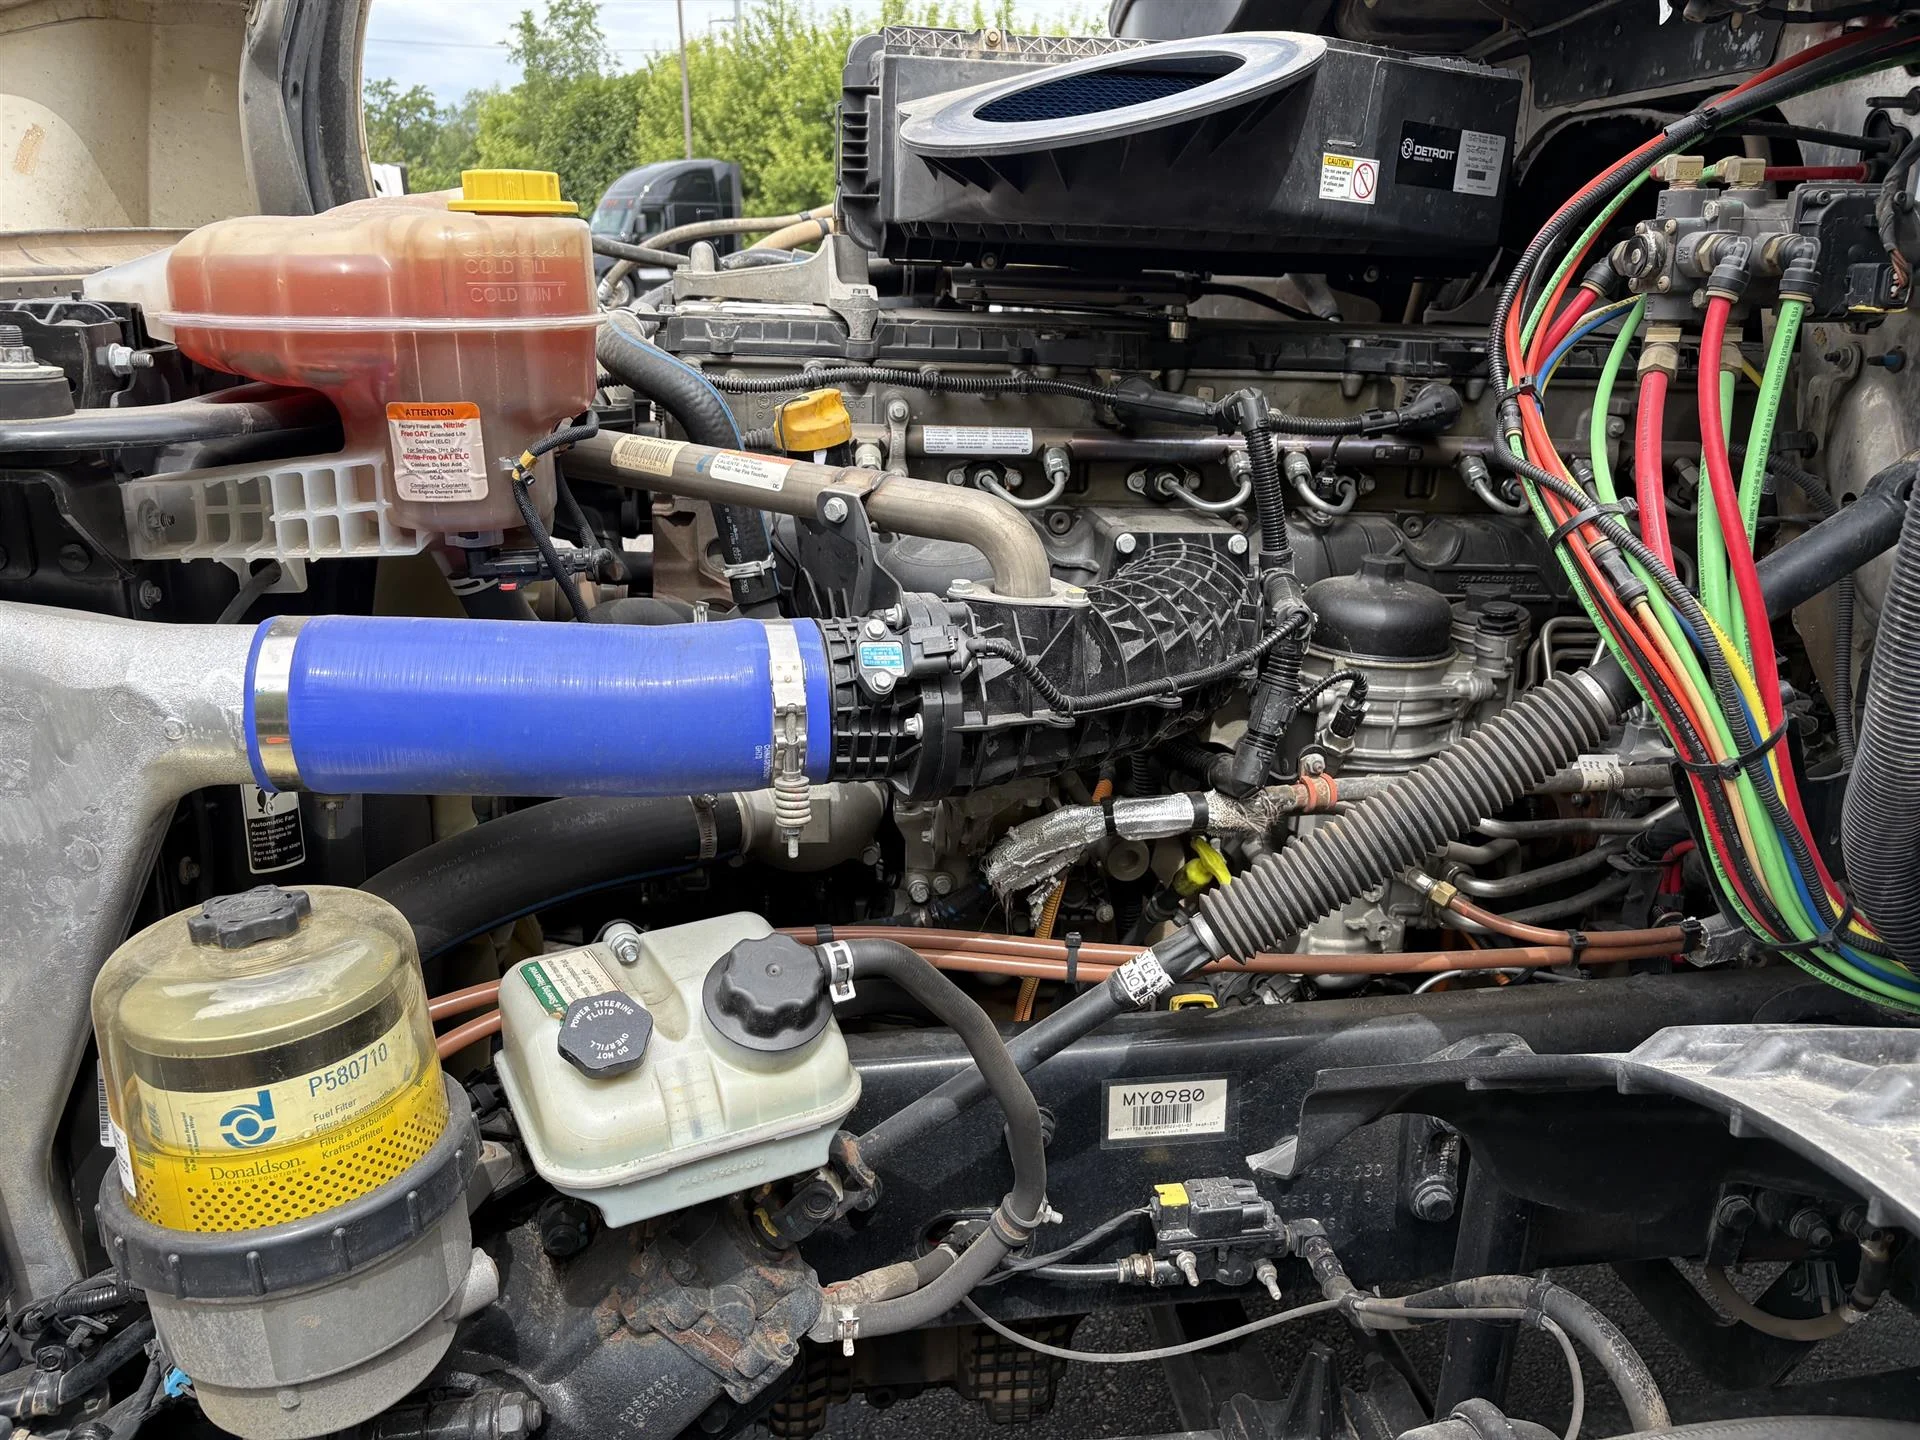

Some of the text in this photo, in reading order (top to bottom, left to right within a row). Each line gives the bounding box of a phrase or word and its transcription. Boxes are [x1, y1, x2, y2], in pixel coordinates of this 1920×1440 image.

[1414, 145, 1456, 160] DETROIT
[1327, 158, 1350, 166] CAUTION
[464, 259, 514, 274] COLD
[470, 287, 518, 302] COLD
[1758, 444, 1766, 456] TYPE
[1687, 727, 1698, 742] TYPE
[251, 817, 284, 828] Automatic
[528, 966, 560, 1007] Steering Reservoir
[570, 1006, 591, 1028] POWER
[594, 1000, 634, 1015] STEERING
[586, 1009, 614, 1021] FLUID
[590, 1033, 629, 1051] OVERFILL
[617, 1045, 629, 1055] DO
[308, 1042, 388, 1098] P580710
[1123, 1088, 1205, 1106] MY0980
[313, 1098, 357, 1123] Fuel Filter
[316, 1119, 340, 1134] Filtro
[342, 1114, 353, 1126] de
[320, 1106, 396, 1148] Filtre à carburant
[322, 1125, 385, 1160] Kraftstofffilter
[210, 1157, 300, 1182] Donaldson
